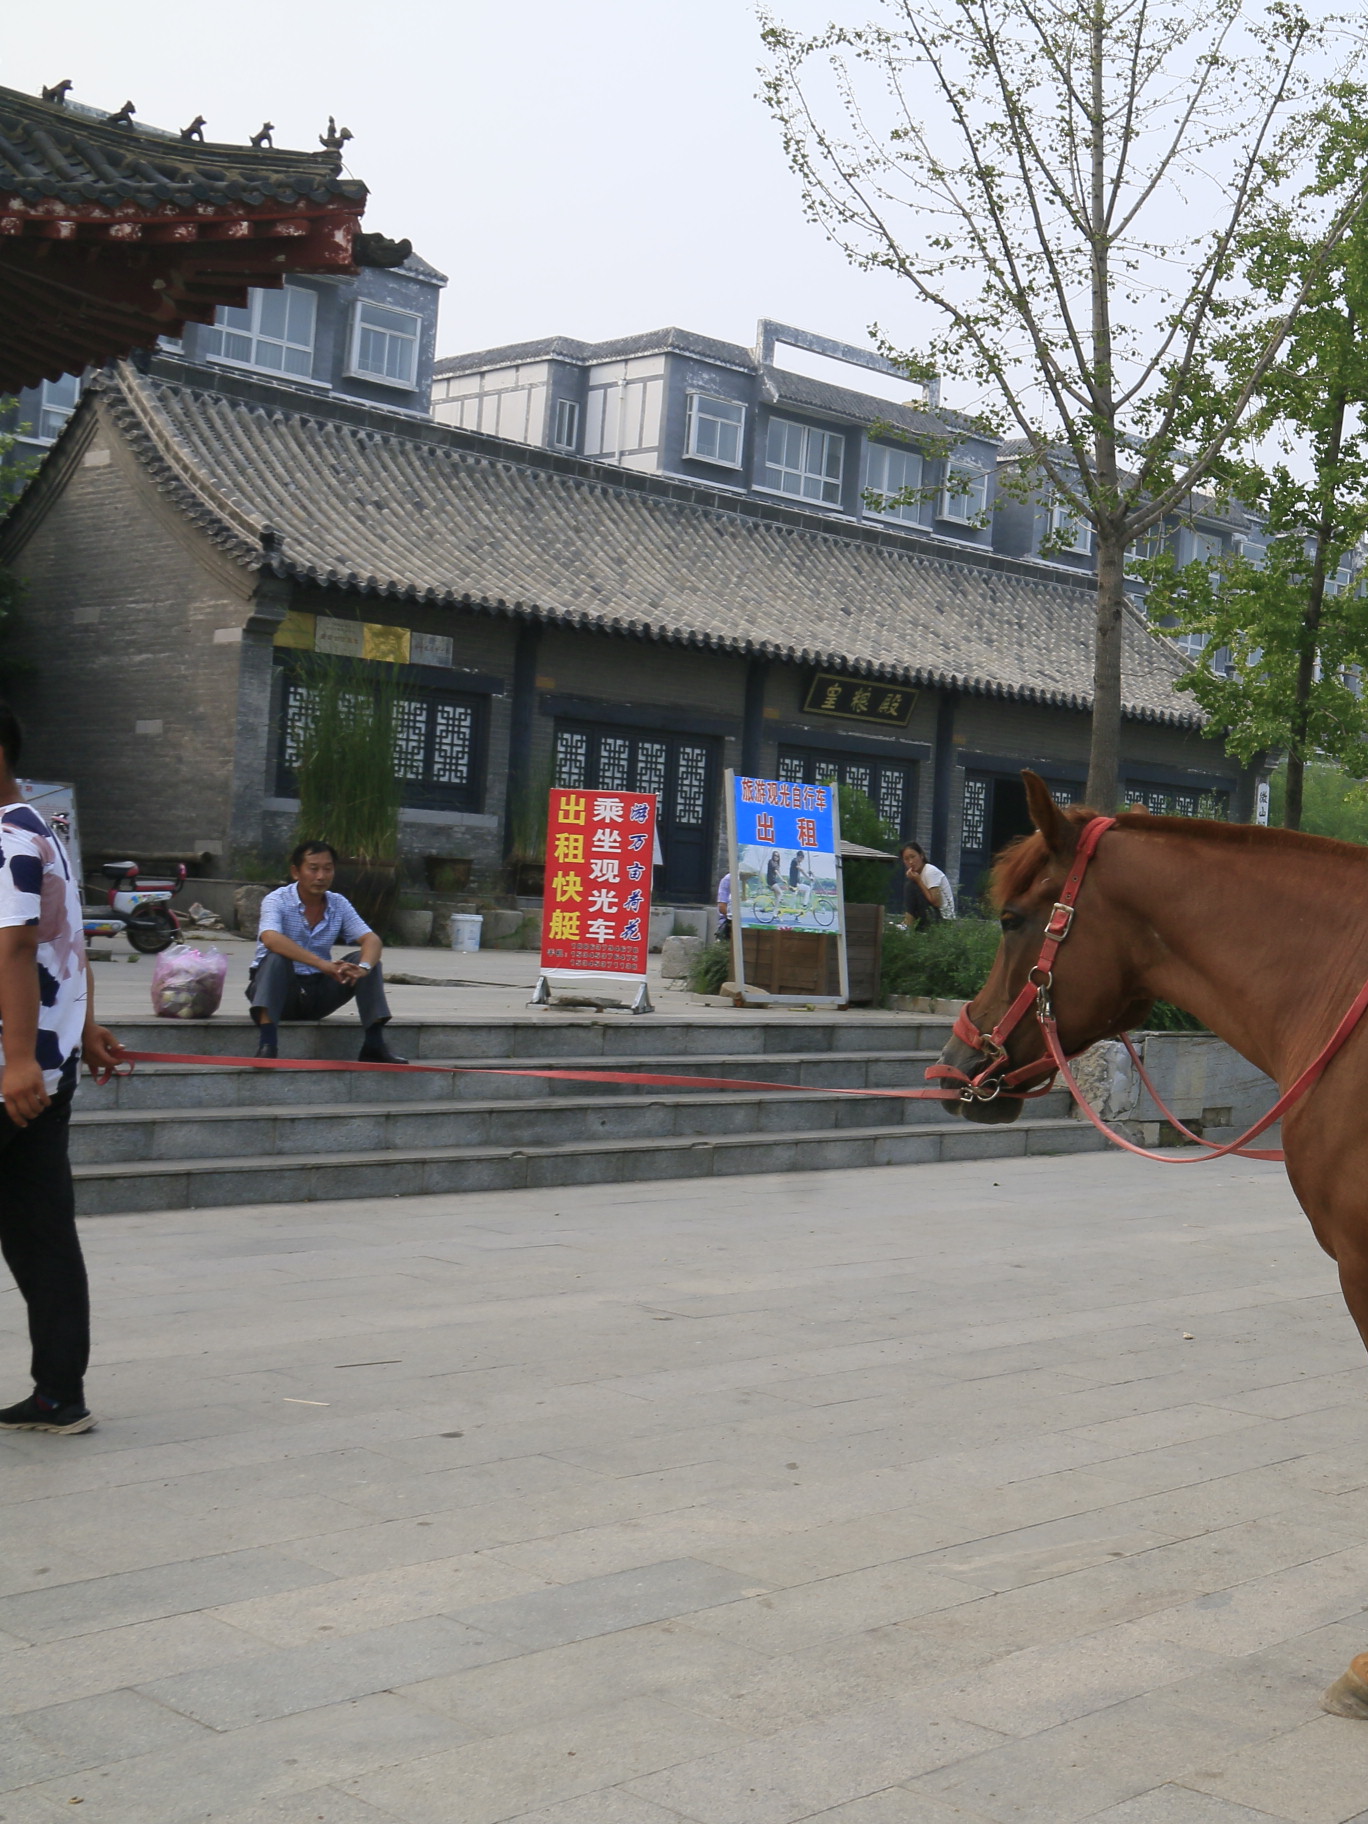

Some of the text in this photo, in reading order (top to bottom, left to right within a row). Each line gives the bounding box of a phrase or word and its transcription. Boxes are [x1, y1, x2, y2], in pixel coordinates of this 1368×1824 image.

[741, 777, 827, 812] 旅游观光自行车
[549, 794, 586, 941] 出租快艇
[585, 797, 625, 944] 乘坐观光车
[620, 802, 650, 941] 游万亩荷花
